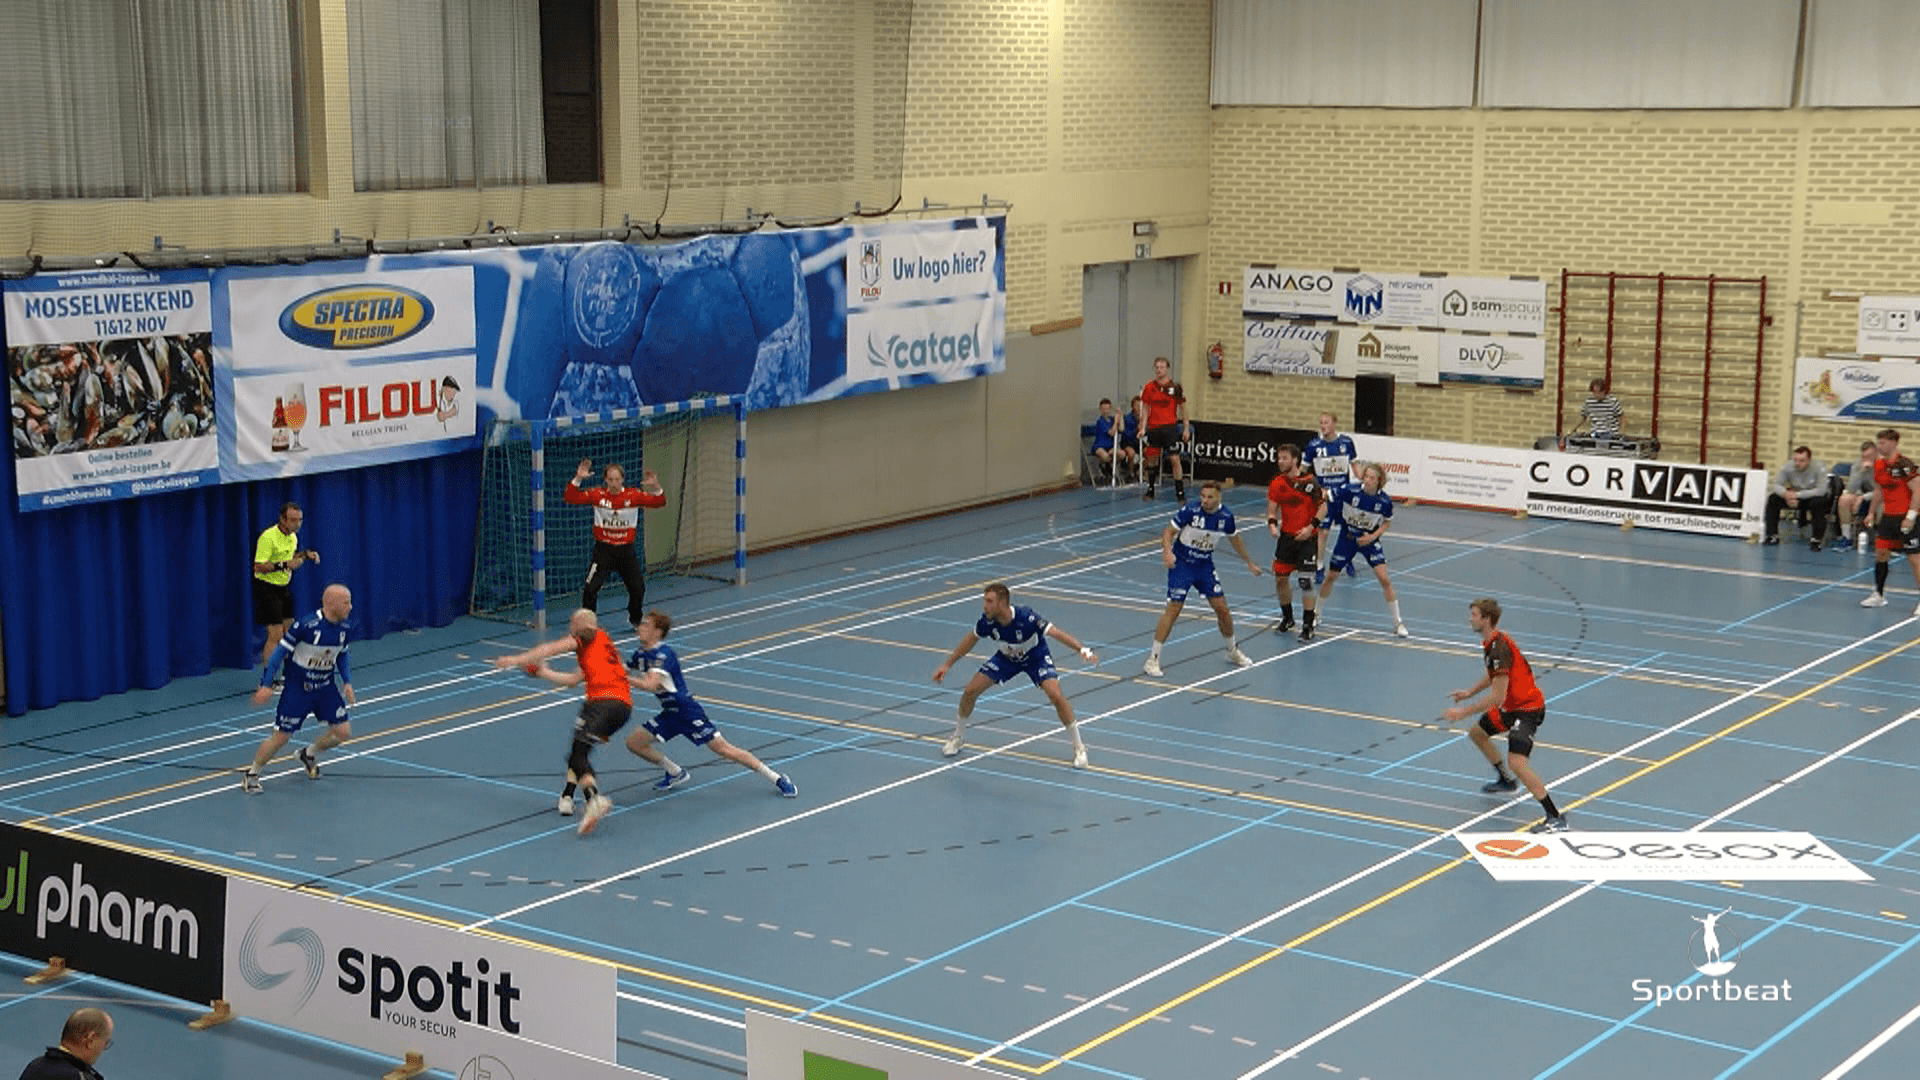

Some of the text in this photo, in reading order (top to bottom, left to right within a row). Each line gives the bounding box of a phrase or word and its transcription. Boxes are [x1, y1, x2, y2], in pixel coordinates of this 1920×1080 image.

[892, 250, 987, 283] Uw logo hier?
[860, 287, 881, 297] FILOU
[1249, 273, 1333, 292] ANAGO
[25, 289, 194, 319] MOSSELWEEKEND
[314, 297, 405, 325] SPECTRA
[95, 316, 167, 336] 11&12 NOV
[339, 325, 395, 341] PRECISION
[894, 322, 980, 369] catael
[318, 378, 438, 428] FILOU
[351, 423, 408, 438] BELGIAN TRIPEL
[88, 448, 153, 464] Online bestellen
[1529, 461, 1742, 503] CORVAN
[1527, 502, 1742, 532] van metaalconstructie tot machinebouw
[313, 629, 322, 645] 7
[37, 862, 198, 960] pharm
[338, 946, 521, 1034] spotit
[384, 1009, 457, 1039] YOUR SECUR
